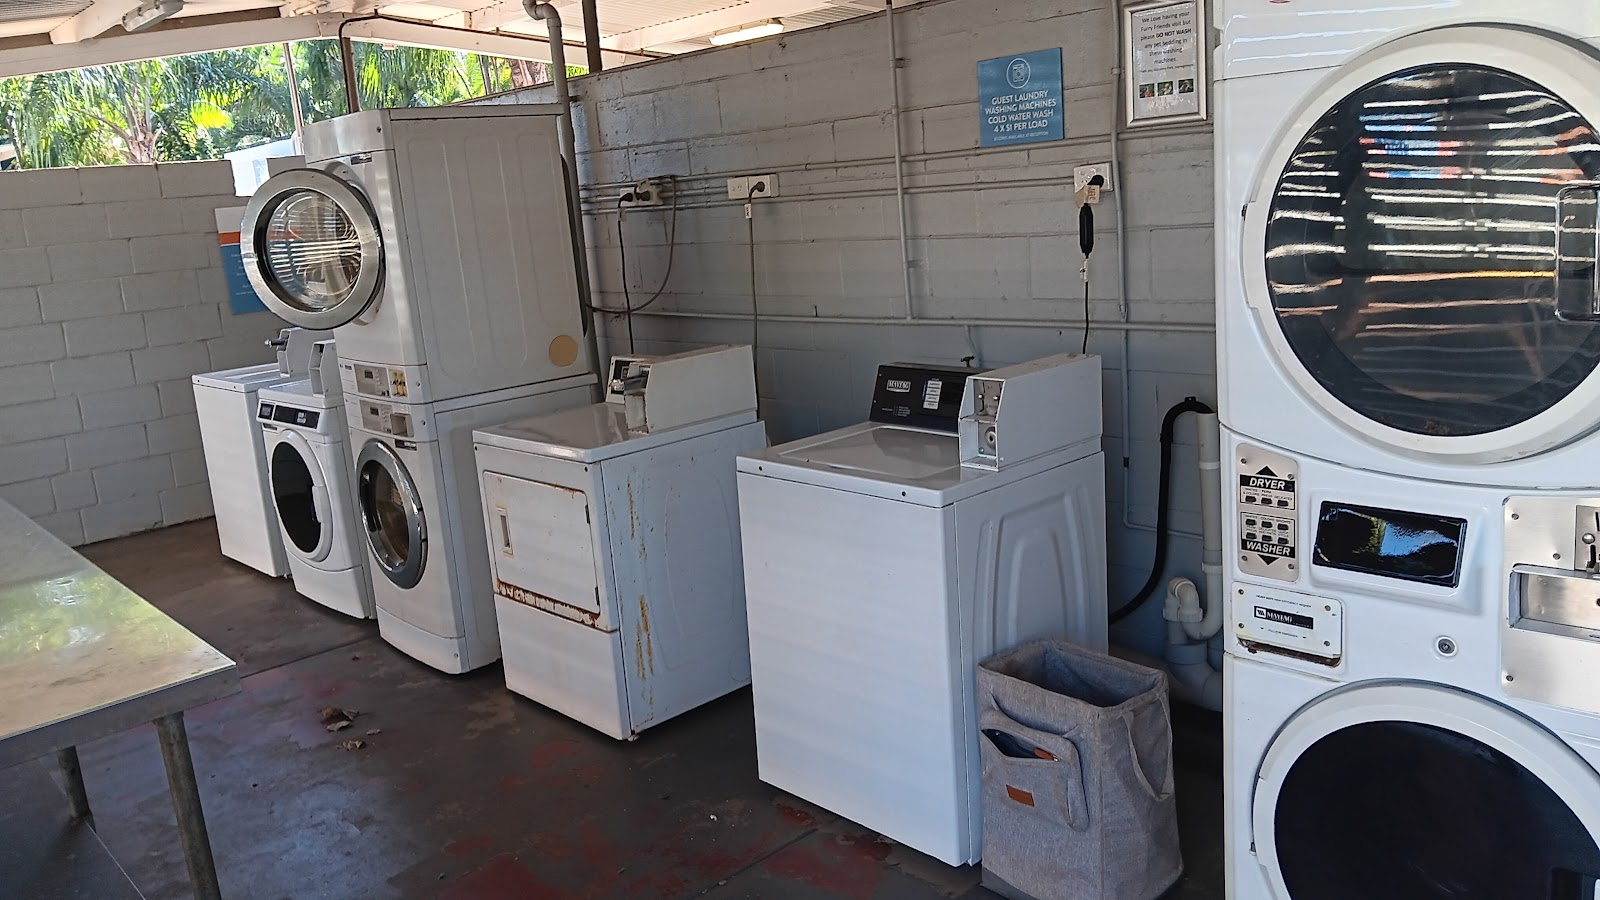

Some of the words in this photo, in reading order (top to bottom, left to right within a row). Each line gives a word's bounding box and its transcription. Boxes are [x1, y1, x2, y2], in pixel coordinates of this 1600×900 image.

[1162, 13, 1178, 21] having
[1179, 11, 1190, 19] your
[1154, 22, 1171, 30] Friends
[1176, 28, 1192, 36] WASH
[992, 95, 1013, 105] GUEST
[1014, 90, 1049, 102] LAUNDRY
[985, 104, 1017, 115] WASHING
[1019, 99, 1057, 111] MACHINES
[988, 115, 1007, 124] COLD
[1008, 112, 1031, 121] WATER
[1033, 109, 1054, 118] WASH
[1028, 120, 1048, 129] LOAD
[1250, 477, 1286, 490] DRYER
[1246, 541, 1291, 555] WASHER
